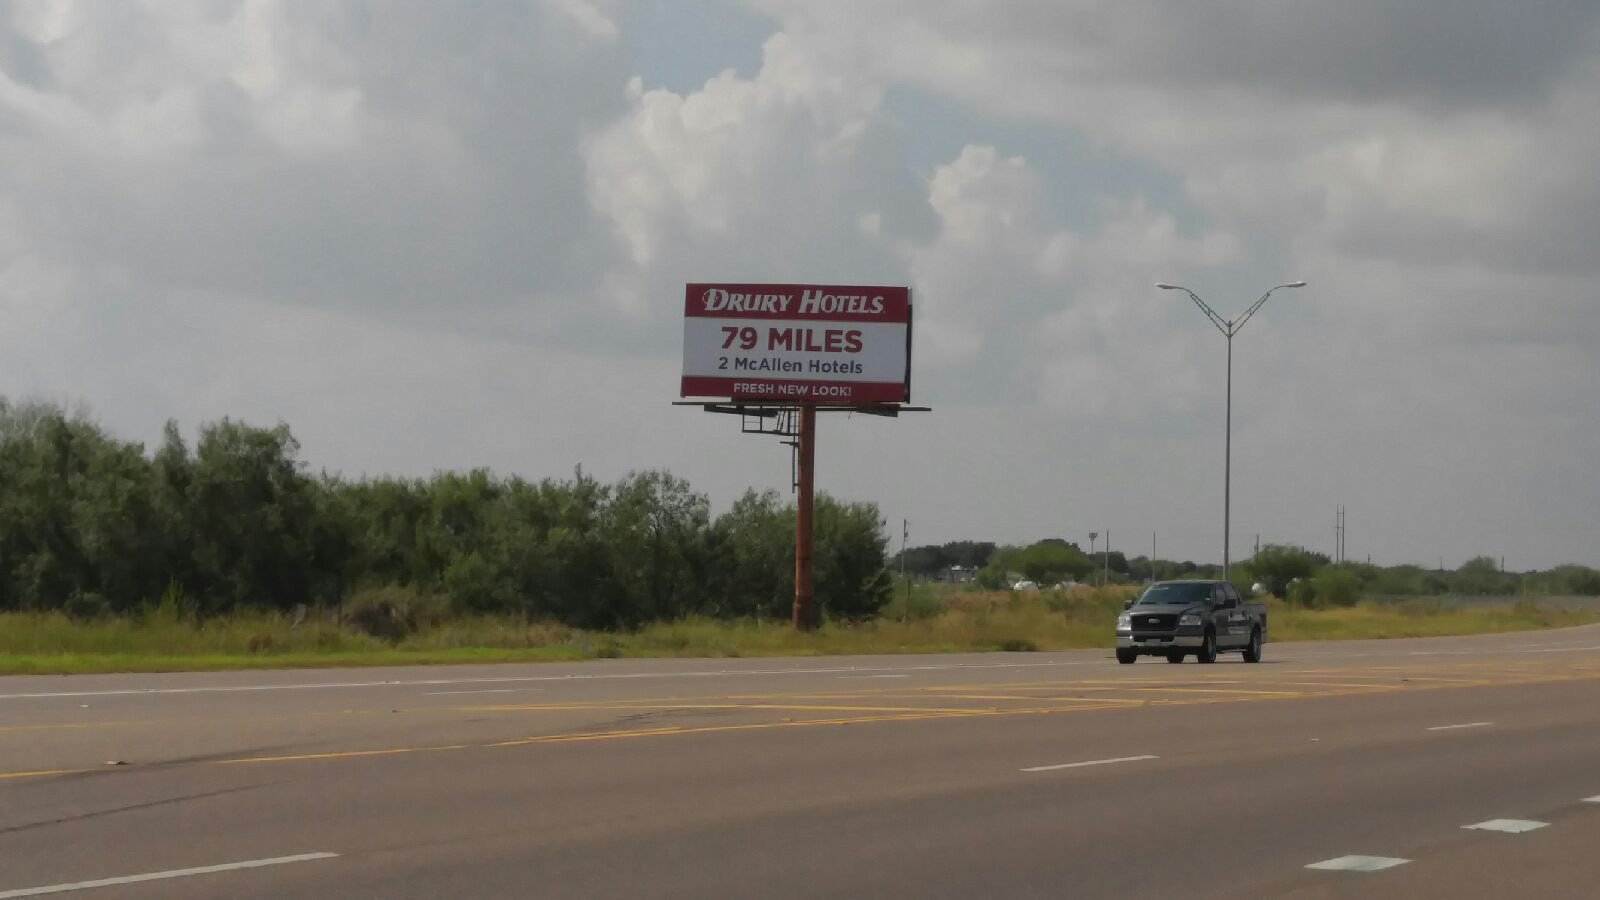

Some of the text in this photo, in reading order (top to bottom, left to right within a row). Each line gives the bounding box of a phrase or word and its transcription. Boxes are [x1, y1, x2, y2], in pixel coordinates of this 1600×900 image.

[703, 288, 884, 314] DRURY HOTELS
[721, 326, 863, 353] 79 MILES
[718, 356, 863, 374] 2 McAllen Hotels
[733, 383, 852, 397] FRESH NEW LOOK!
